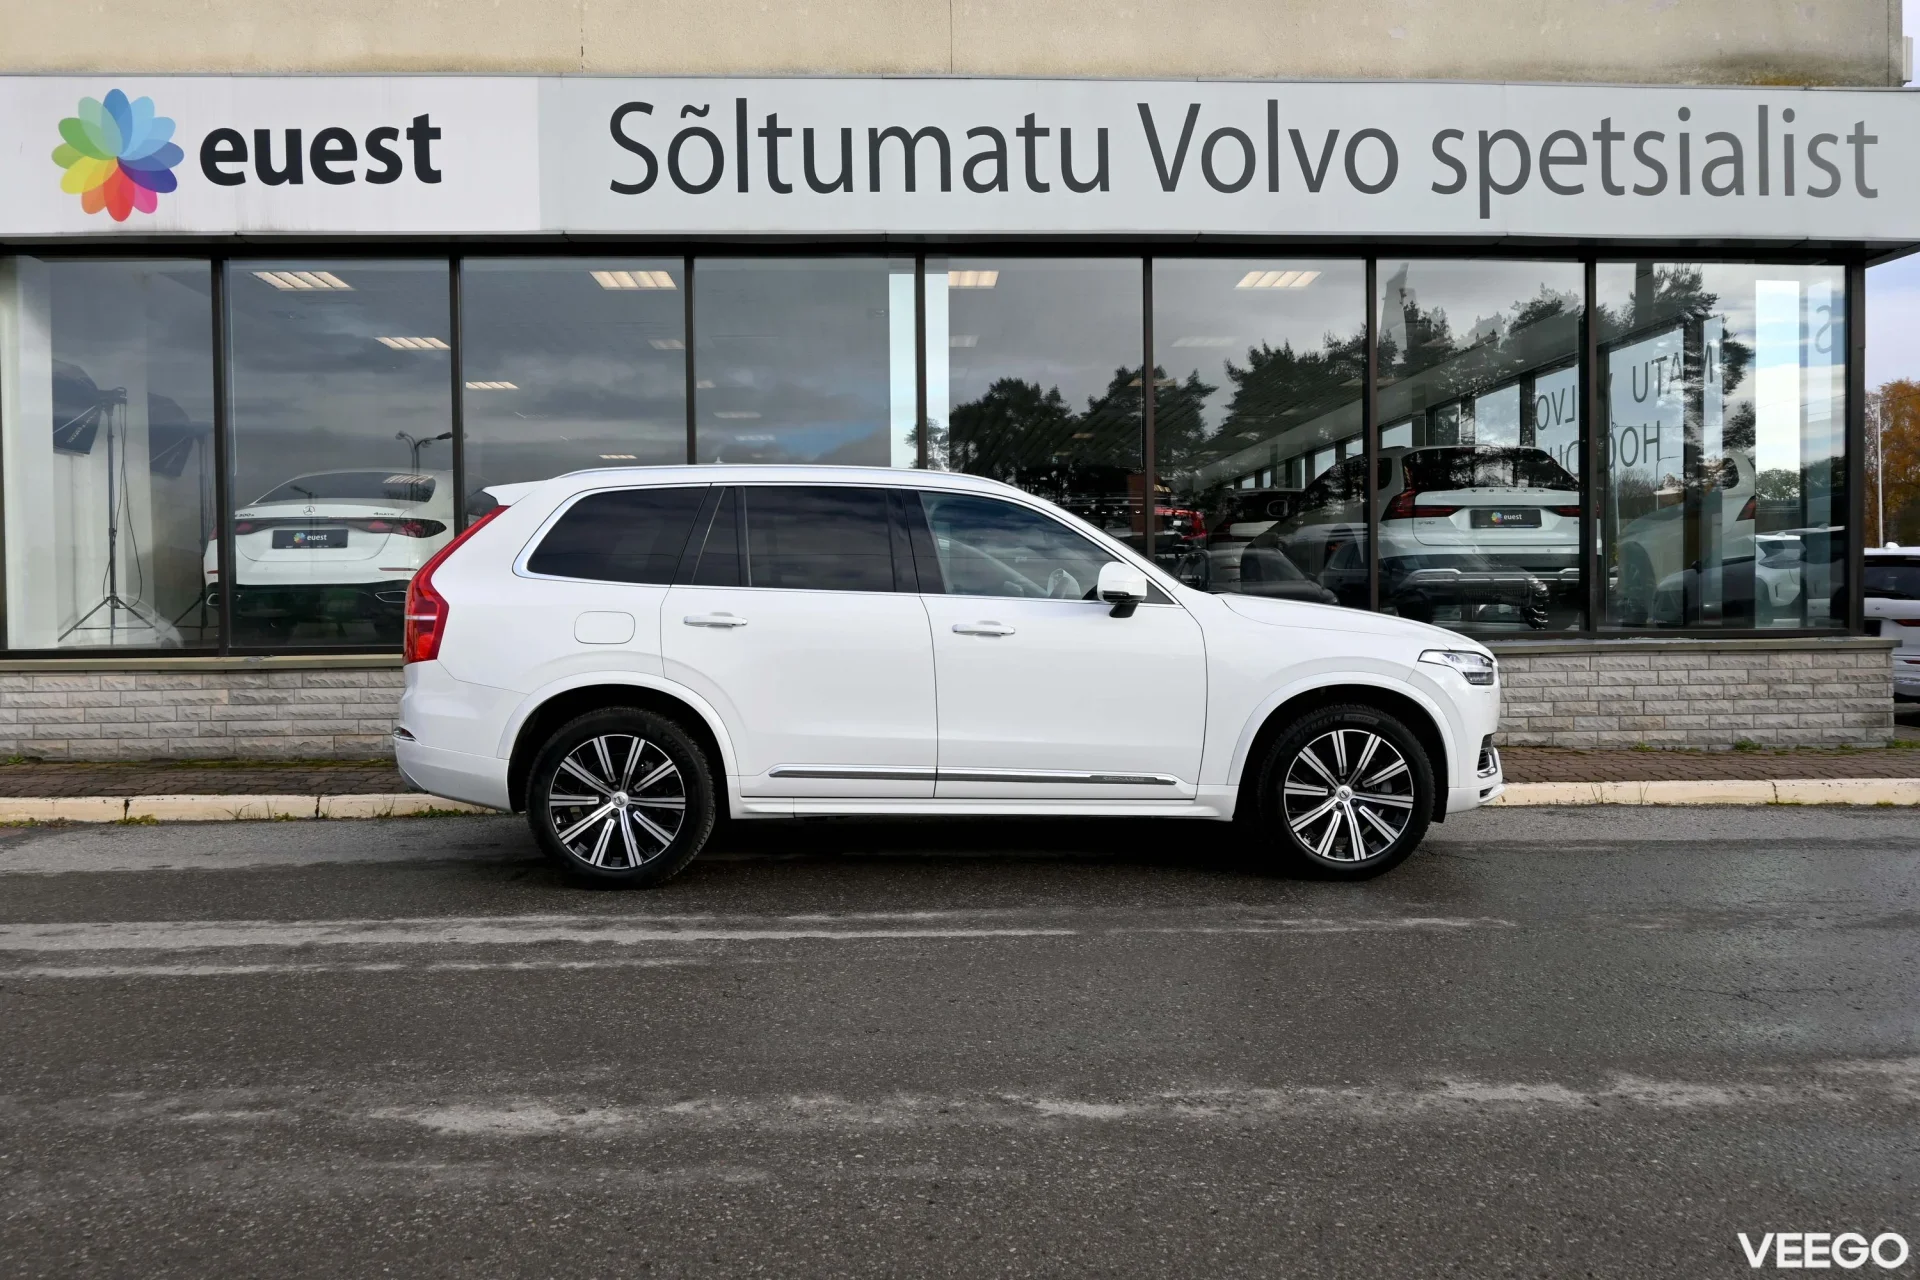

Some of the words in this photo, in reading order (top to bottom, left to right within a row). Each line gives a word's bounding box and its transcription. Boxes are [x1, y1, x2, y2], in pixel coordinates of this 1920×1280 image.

[200, 113, 442, 187] euest
[610, 98, 1109, 196] Sõltumatu
[1137, 98, 1399, 195] Volvo
[1432, 104, 1878, 220] spetsialist
[1503, 513, 1523, 521] euest
